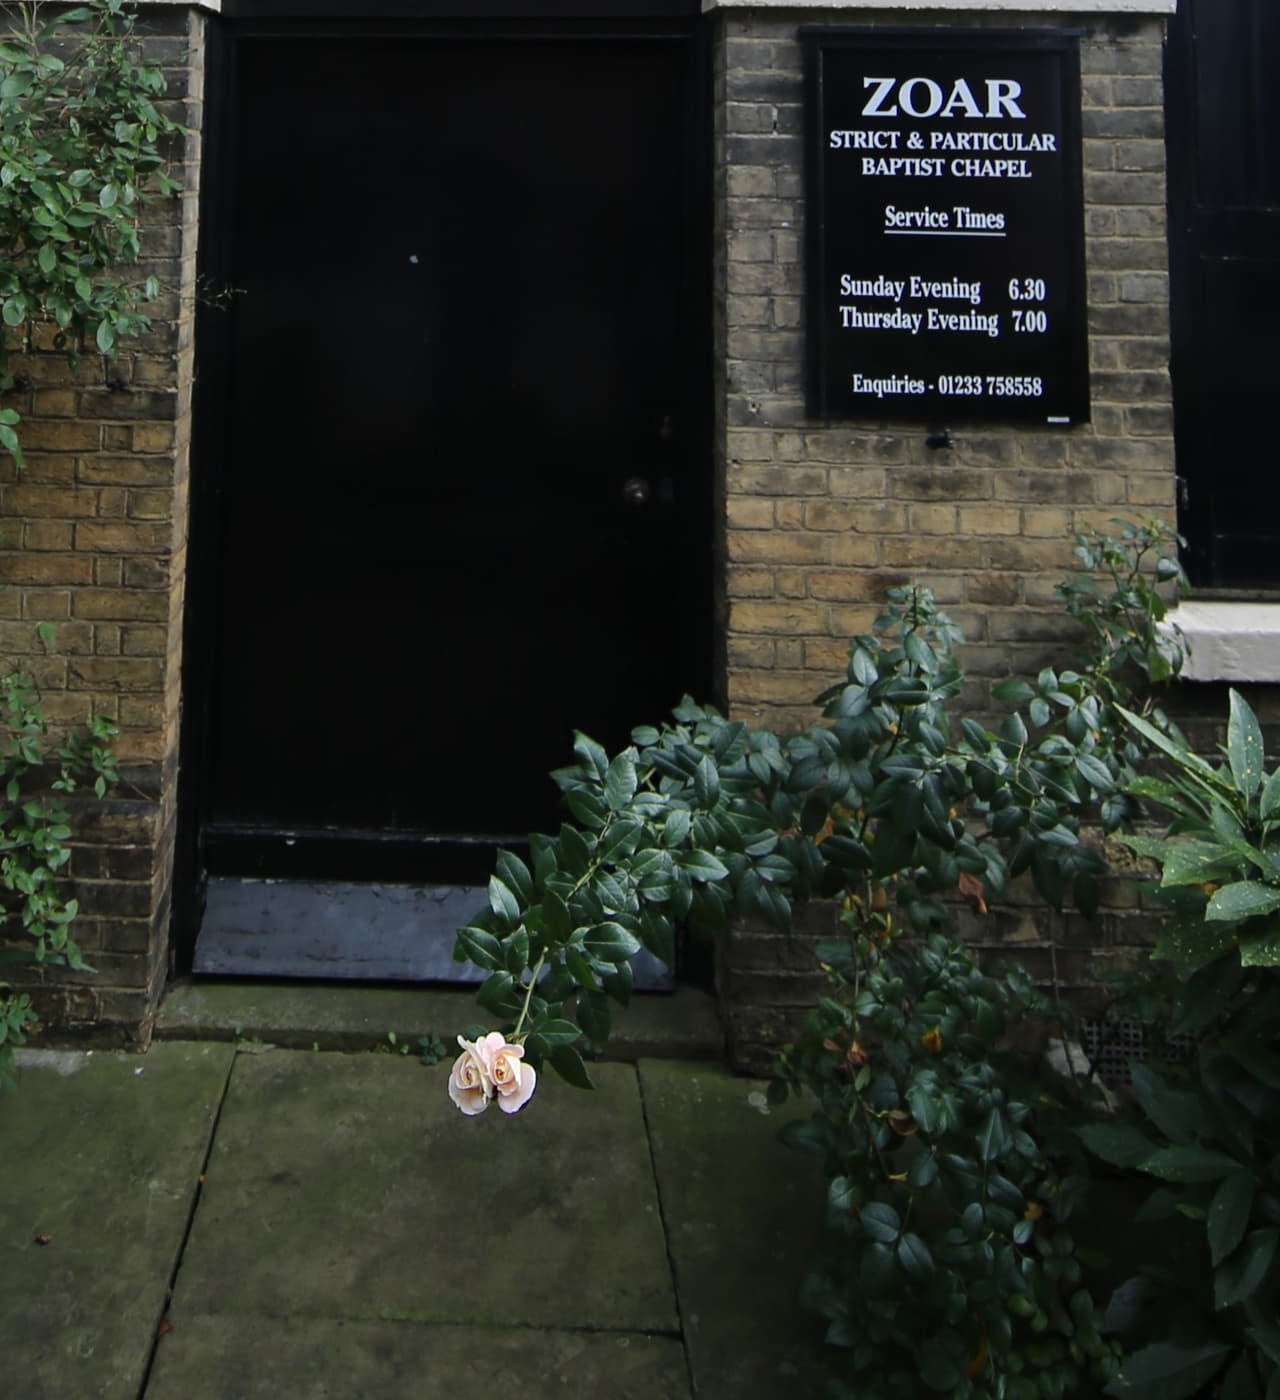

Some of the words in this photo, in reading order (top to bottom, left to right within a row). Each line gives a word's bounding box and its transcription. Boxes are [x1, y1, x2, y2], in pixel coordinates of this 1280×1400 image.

[861, 76, 1027, 119] ZOAR
[829, 130, 901, 149] STRICT
[906, 131, 925, 150] &
[930, 131, 1057, 152] PARTICULAR
[861, 157, 946, 177] BAPTIST
[950, 158, 1033, 178] CHAPEL
[884, 205, 949, 228] Service
[952, 206, 1005, 230] Times
[840, 274, 905, 303] Sunday
[909, 276, 981, 305] Evening
[1008, 278, 1046, 301] 6.30
[839, 305, 923, 335] Thursday
[927, 308, 999, 337] Evening
[1011, 310, 1047, 333] 7.00
[852, 373, 925, 398] Enquiries
[938, 375, 983, 396] 01233
[986, 376, 1043, 397] 758558
